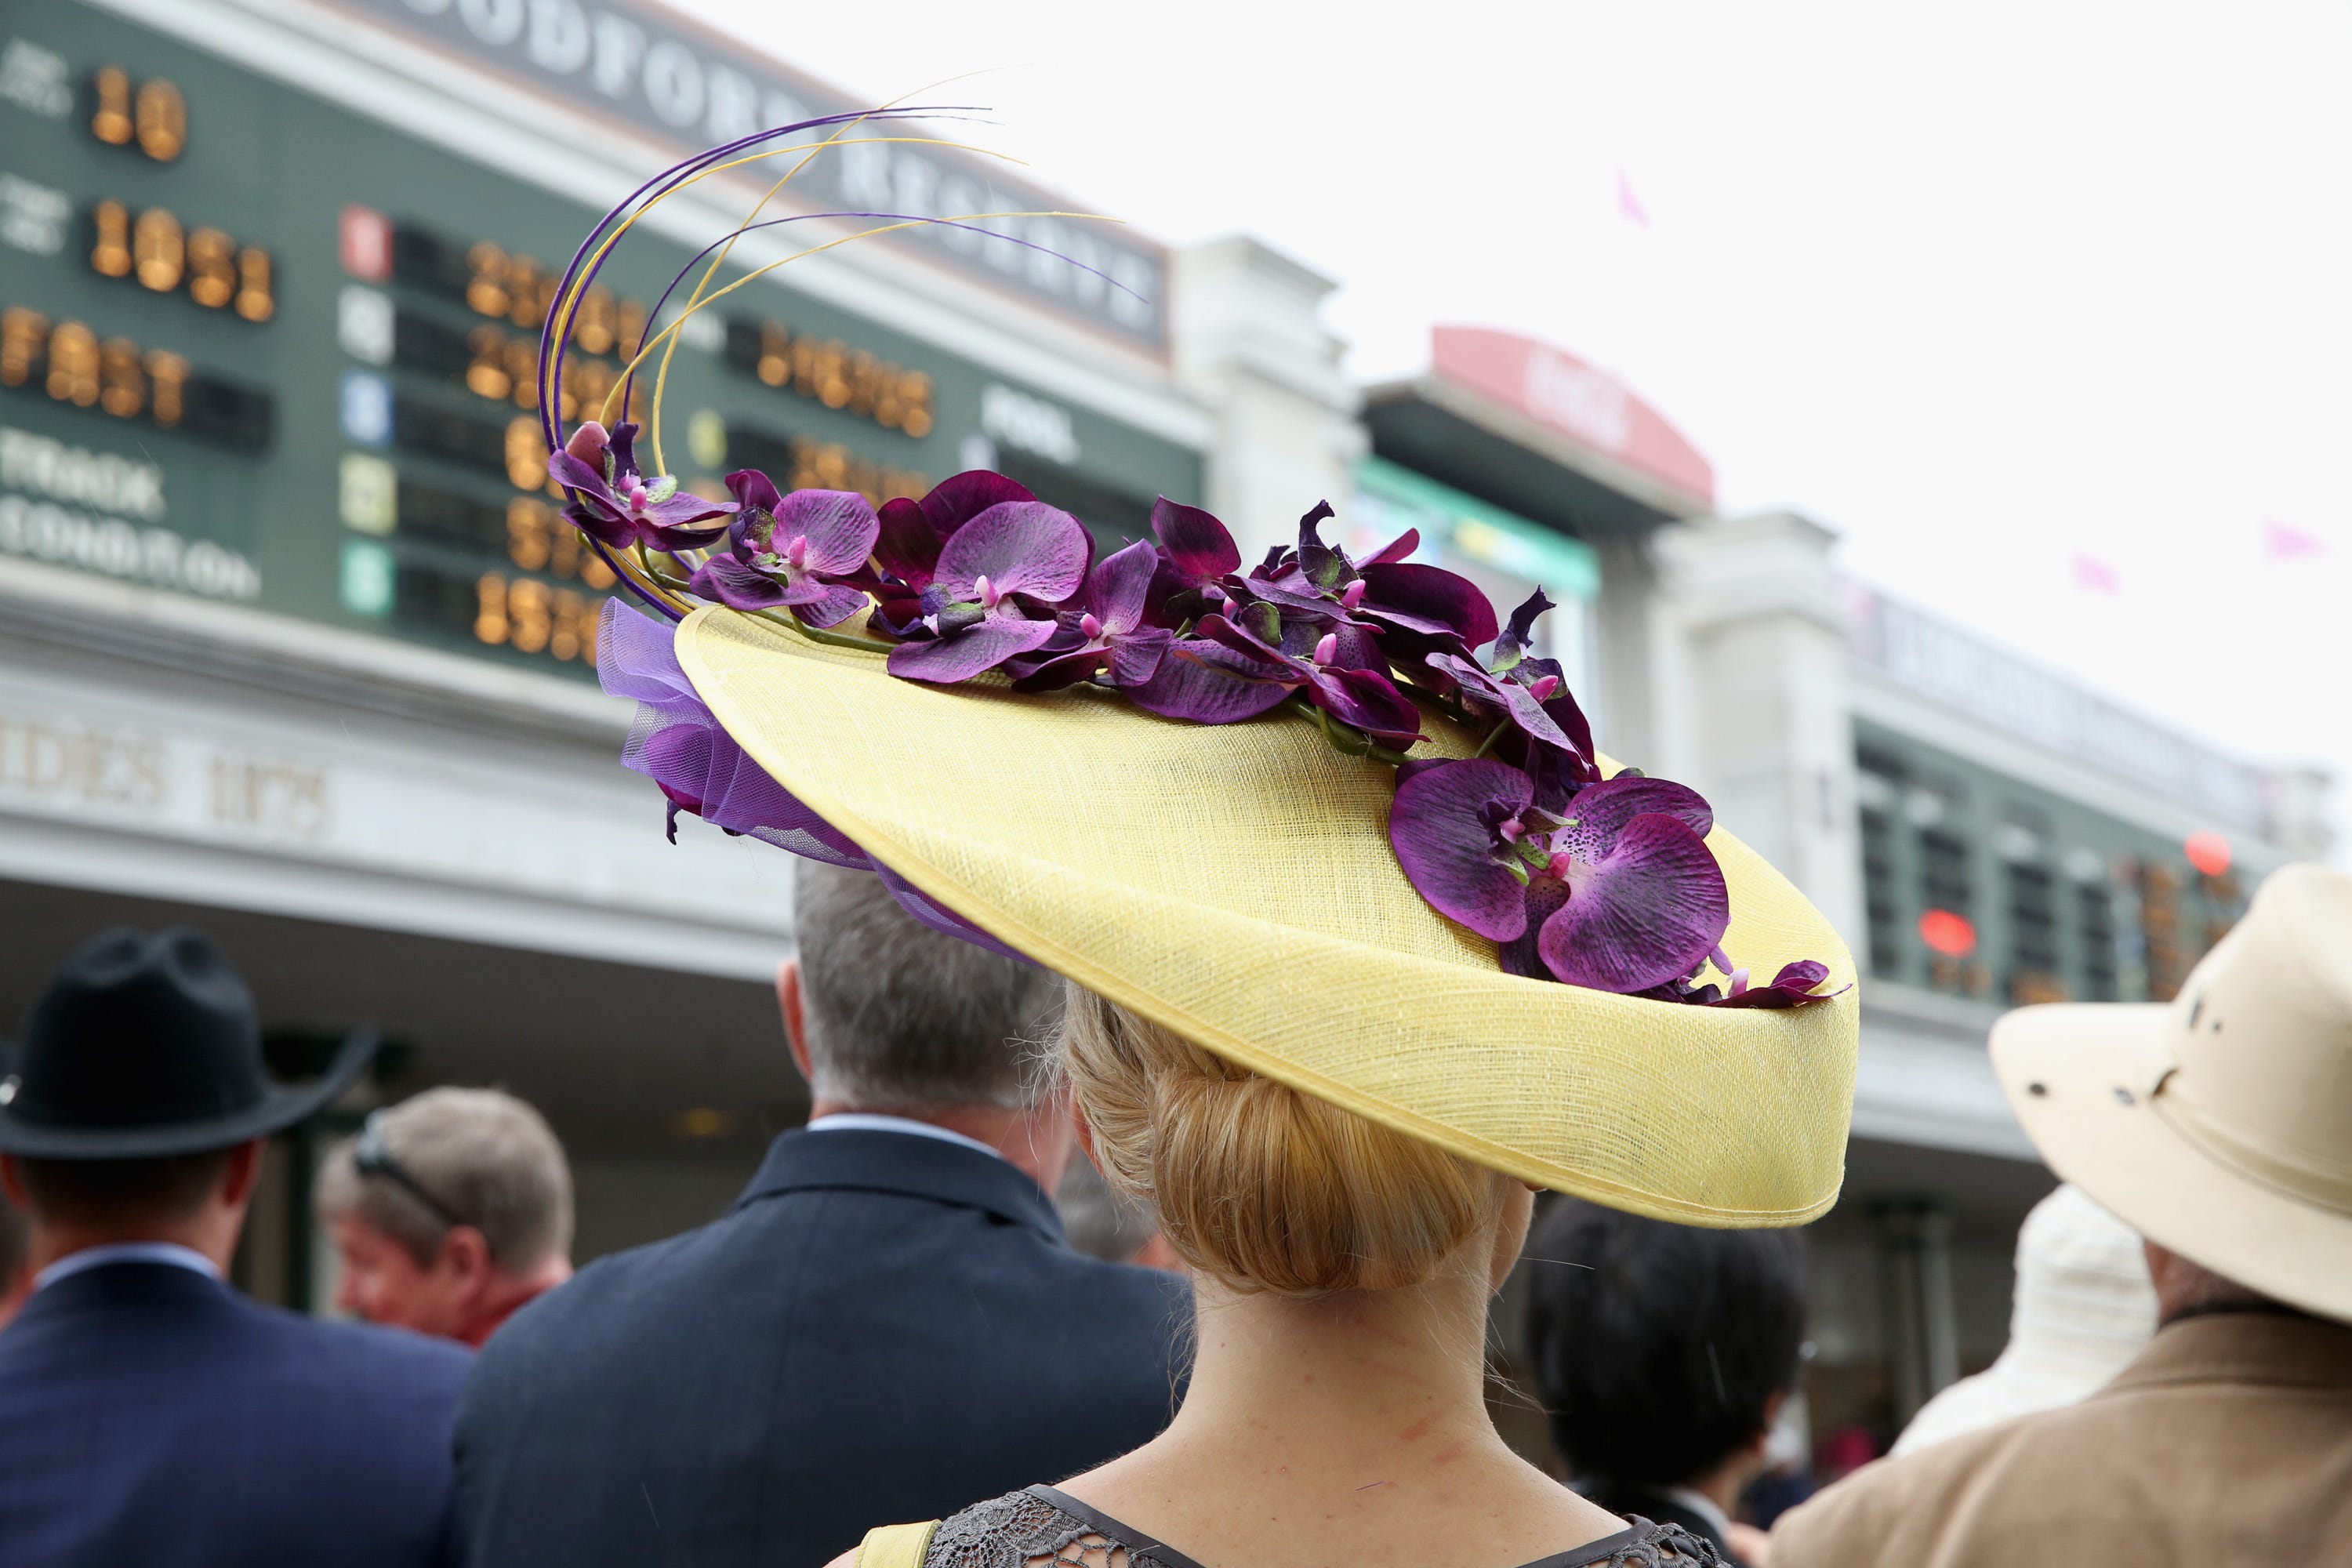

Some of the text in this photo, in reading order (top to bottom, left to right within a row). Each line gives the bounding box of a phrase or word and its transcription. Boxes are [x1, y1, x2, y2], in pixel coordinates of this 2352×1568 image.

[93, 62, 187, 162] 10
[401, 0, 818, 176] ODFORD
[839, 119, 1152, 329] RESERVE
[0, 305, 191, 427] FAST
[0, 426, 167, 522] TRACK
[0, 493, 262, 601] CONDITION
